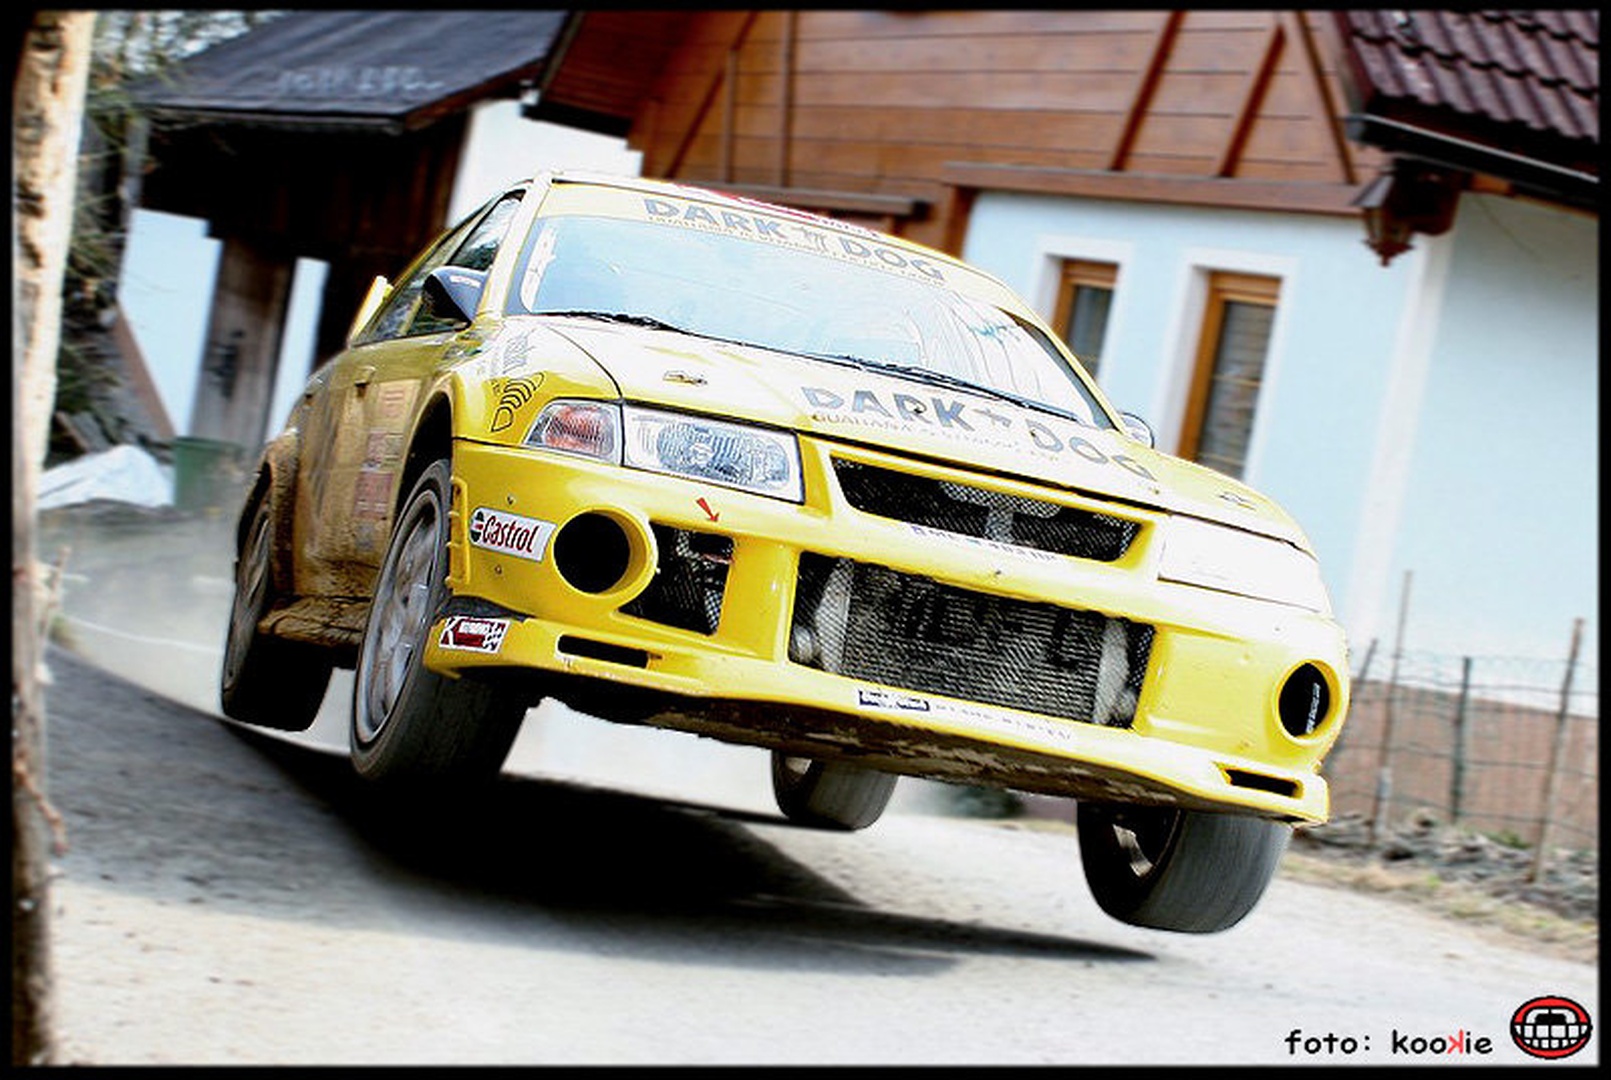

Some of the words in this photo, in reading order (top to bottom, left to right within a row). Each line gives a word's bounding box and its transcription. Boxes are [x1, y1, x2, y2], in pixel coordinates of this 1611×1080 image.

[644, 198, 787, 238] DARK
[839, 235, 945, 281] DOG
[800, 386, 975, 432] DARK
[1024, 417, 1159, 483] DOG
[482, 515, 540, 554] Castrol
